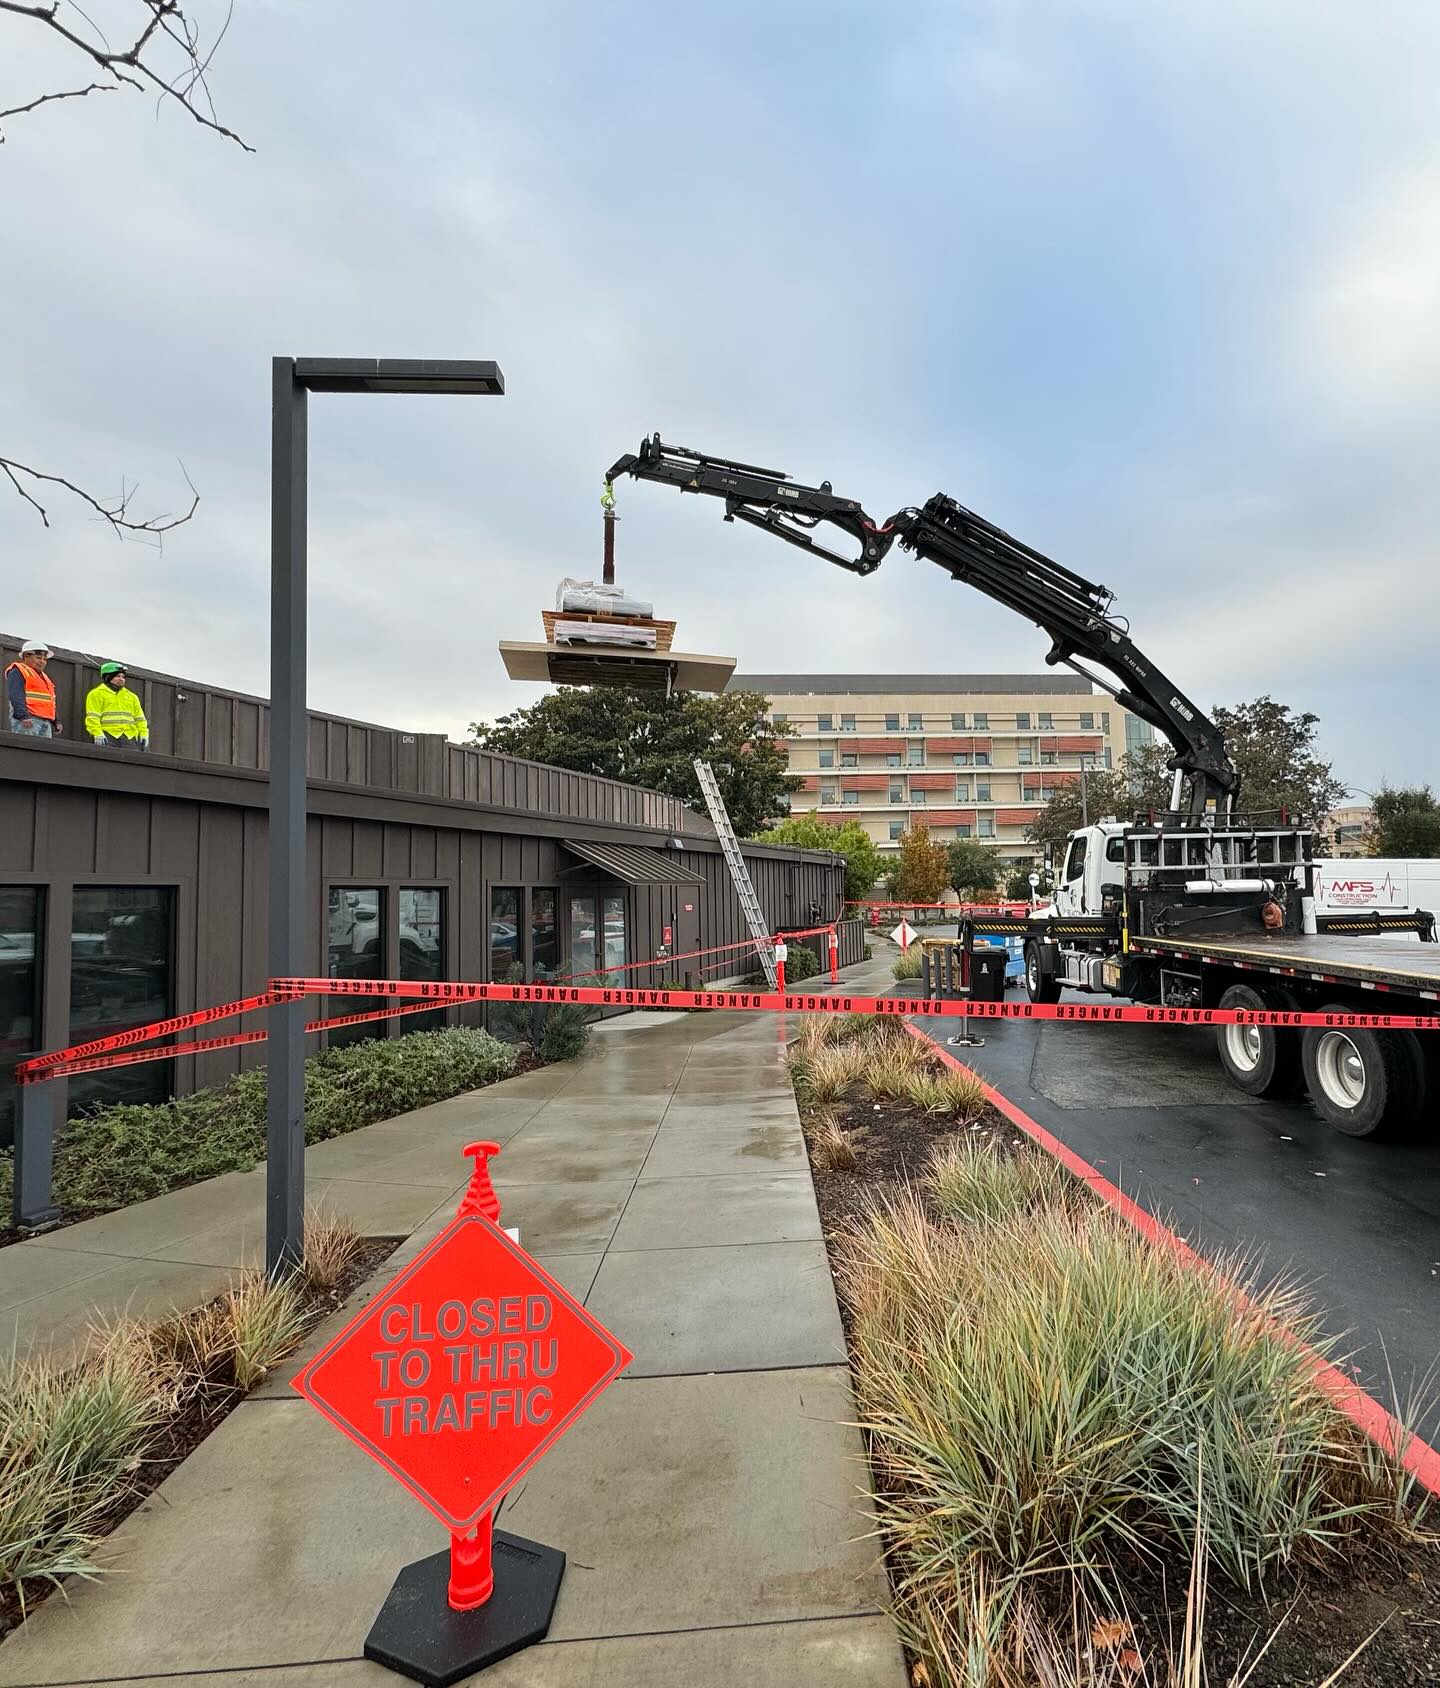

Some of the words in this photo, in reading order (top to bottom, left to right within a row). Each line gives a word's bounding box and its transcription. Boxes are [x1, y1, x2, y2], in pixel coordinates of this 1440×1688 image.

[1331, 881, 1375, 893] MFS
[421, 984, 488, 998] DANGER
[512, 987, 579, 1001] DANGER
[603, 990, 670, 1004] DANGER
[694, 994, 761, 1008] DANGER
[785, 997, 851, 1011] DANGER
[875, 1000, 942, 1014] DANGER
[966, 1003, 1032, 1017] DANGER
[1056, 1006, 1122, 1019] DANGER
[1146, 1009, 1212, 1022] DANGER
[1236, 1011, 1302, 1024] DANGER
[379, 1294, 553, 1344] CLOSED
[371, 1349, 431, 1390] TO
[443, 1339, 559, 1385] THRU
[374, 1386, 553, 1438] TRAFFIC
